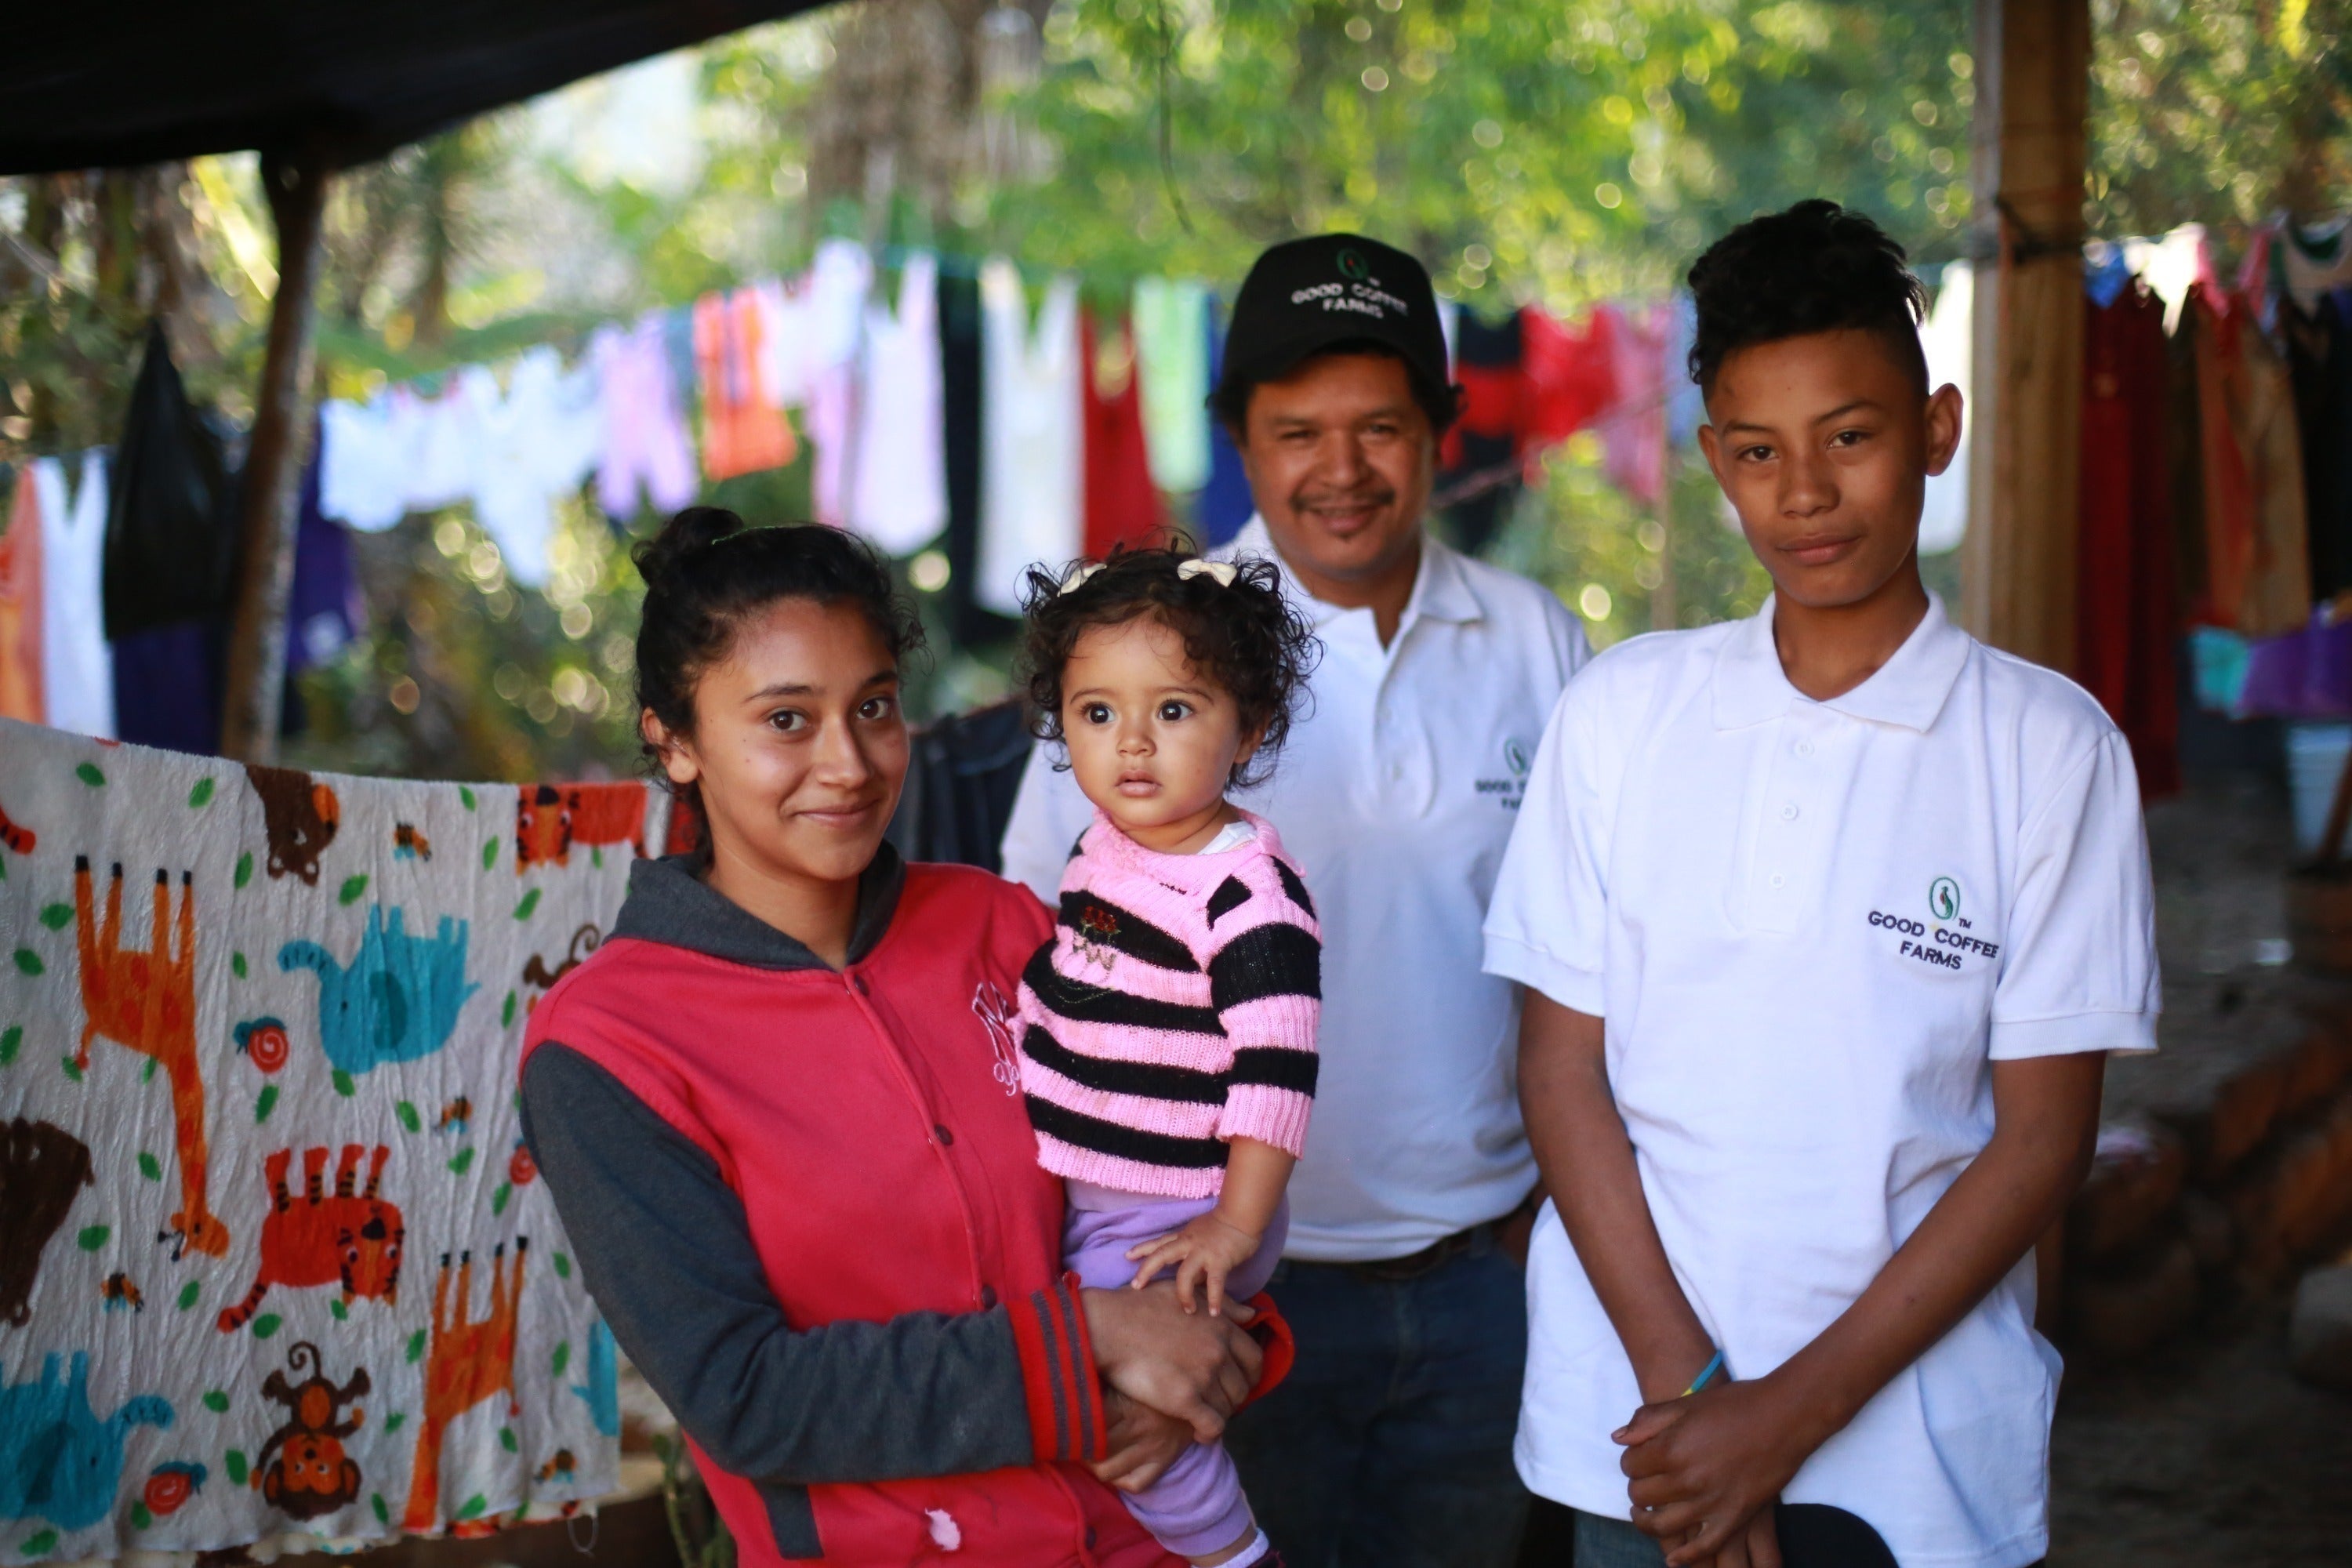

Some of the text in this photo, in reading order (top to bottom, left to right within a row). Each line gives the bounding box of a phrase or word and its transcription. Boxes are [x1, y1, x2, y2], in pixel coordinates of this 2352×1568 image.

[1291, 283, 1343, 304] GOOD
[1868, 911, 1999, 959] GOOD COFFEE
[1959, 917, 1972, 929] TM
[1900, 941, 1962, 970] FARMS
